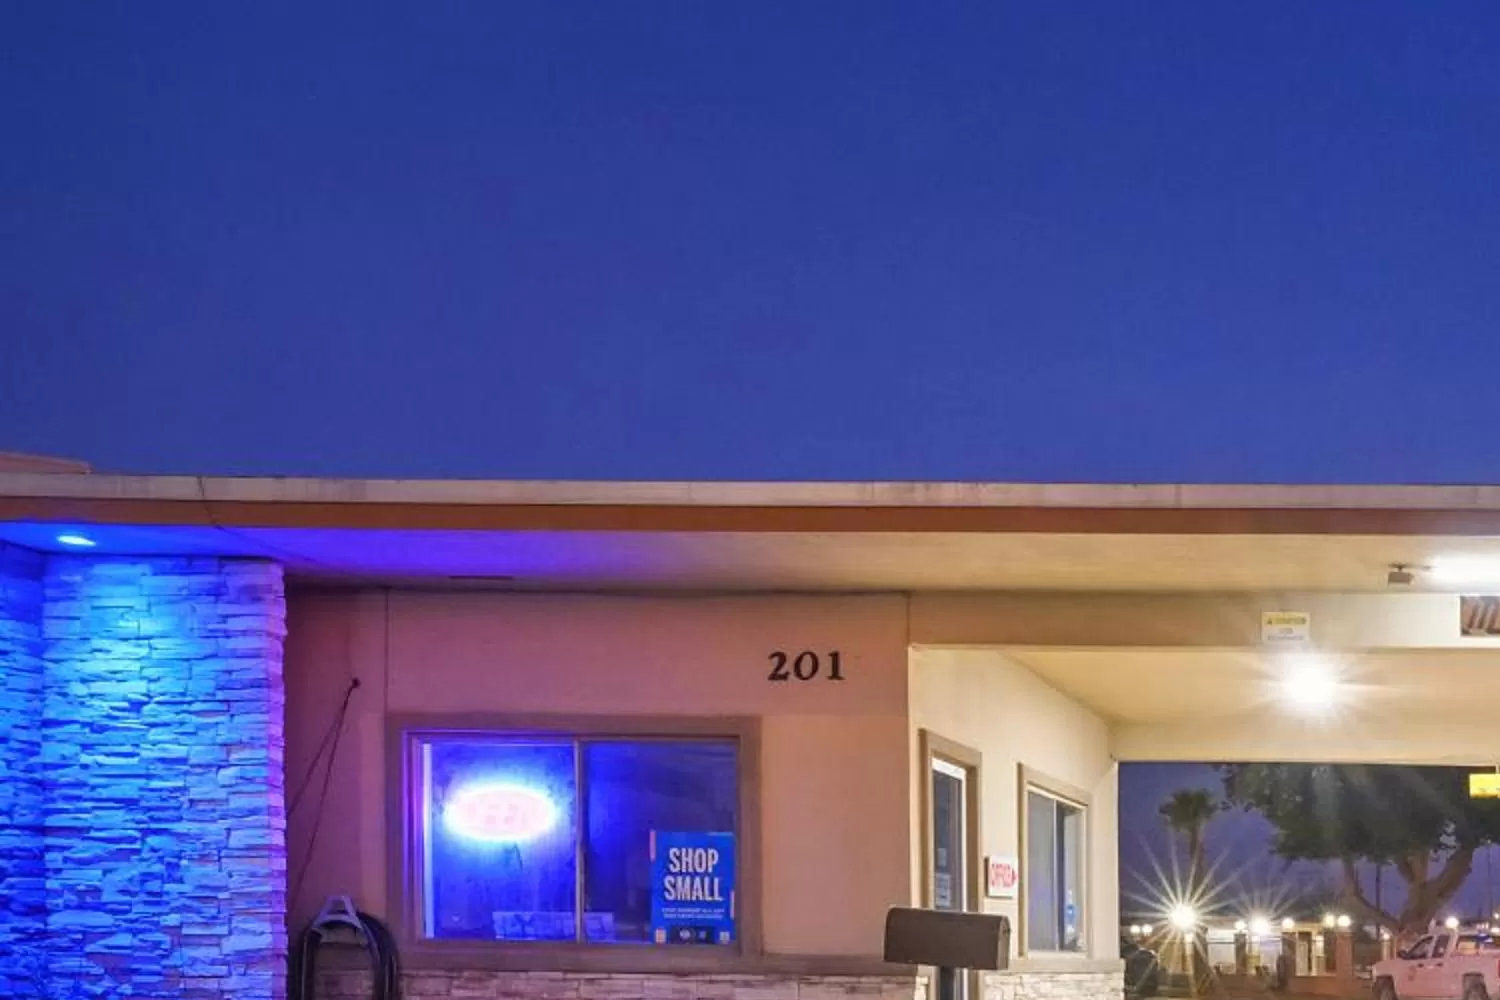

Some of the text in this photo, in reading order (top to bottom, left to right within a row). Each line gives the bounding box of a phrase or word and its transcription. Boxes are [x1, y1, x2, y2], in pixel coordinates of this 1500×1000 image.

[767, 649, 846, 681] 201
[668, 847, 720, 873] SHOP
[663, 875, 725, 902] SMALL
